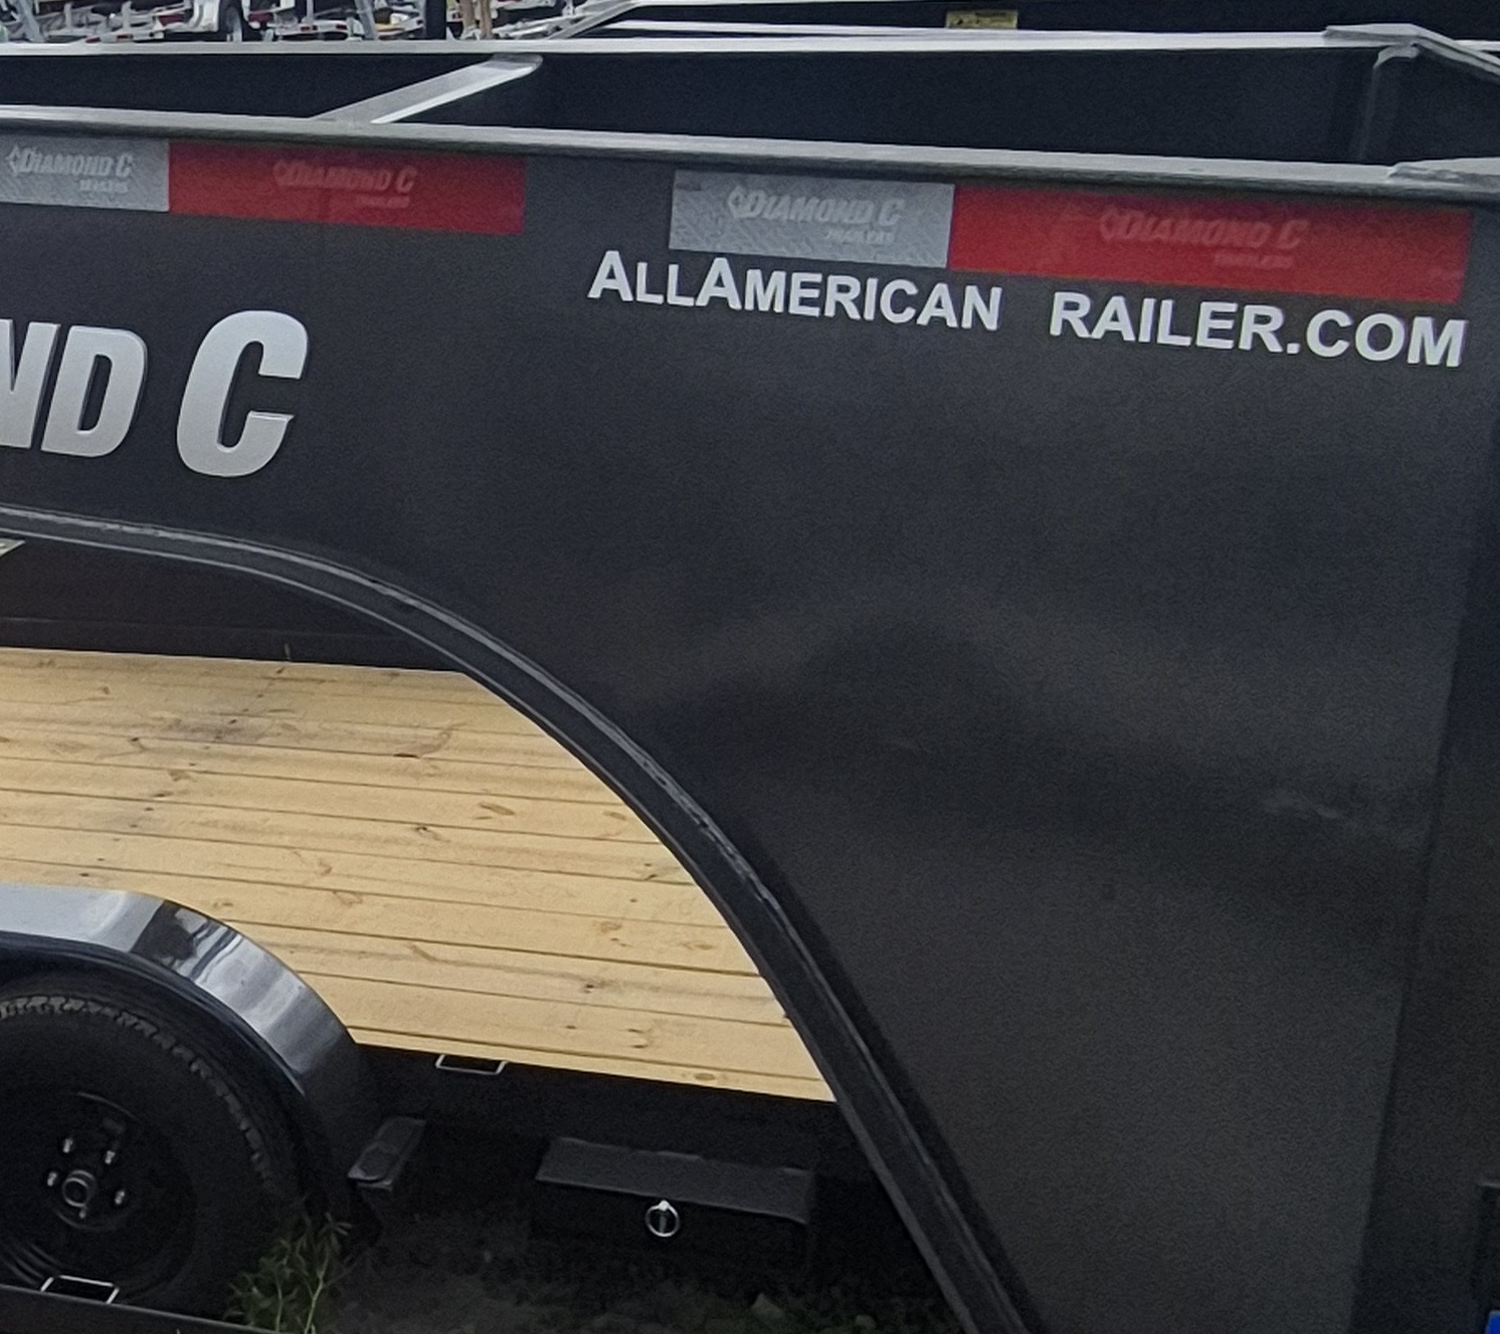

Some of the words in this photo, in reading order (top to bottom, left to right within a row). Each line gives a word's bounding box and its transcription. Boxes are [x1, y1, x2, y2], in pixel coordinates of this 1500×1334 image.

[19, 147, 112, 177] DIAMOND
[116, 153, 133, 178] C
[396, 165, 418, 193] C
[746, 188, 875, 224] DIAMOND
[879, 198, 905, 227] C
[1276, 219, 1309, 250] C
[588, 250, 1003, 331] ALLAMERICAN
[1050, 291, 1468, 367] RAILER.COM
[176, 310, 308, 478] C
